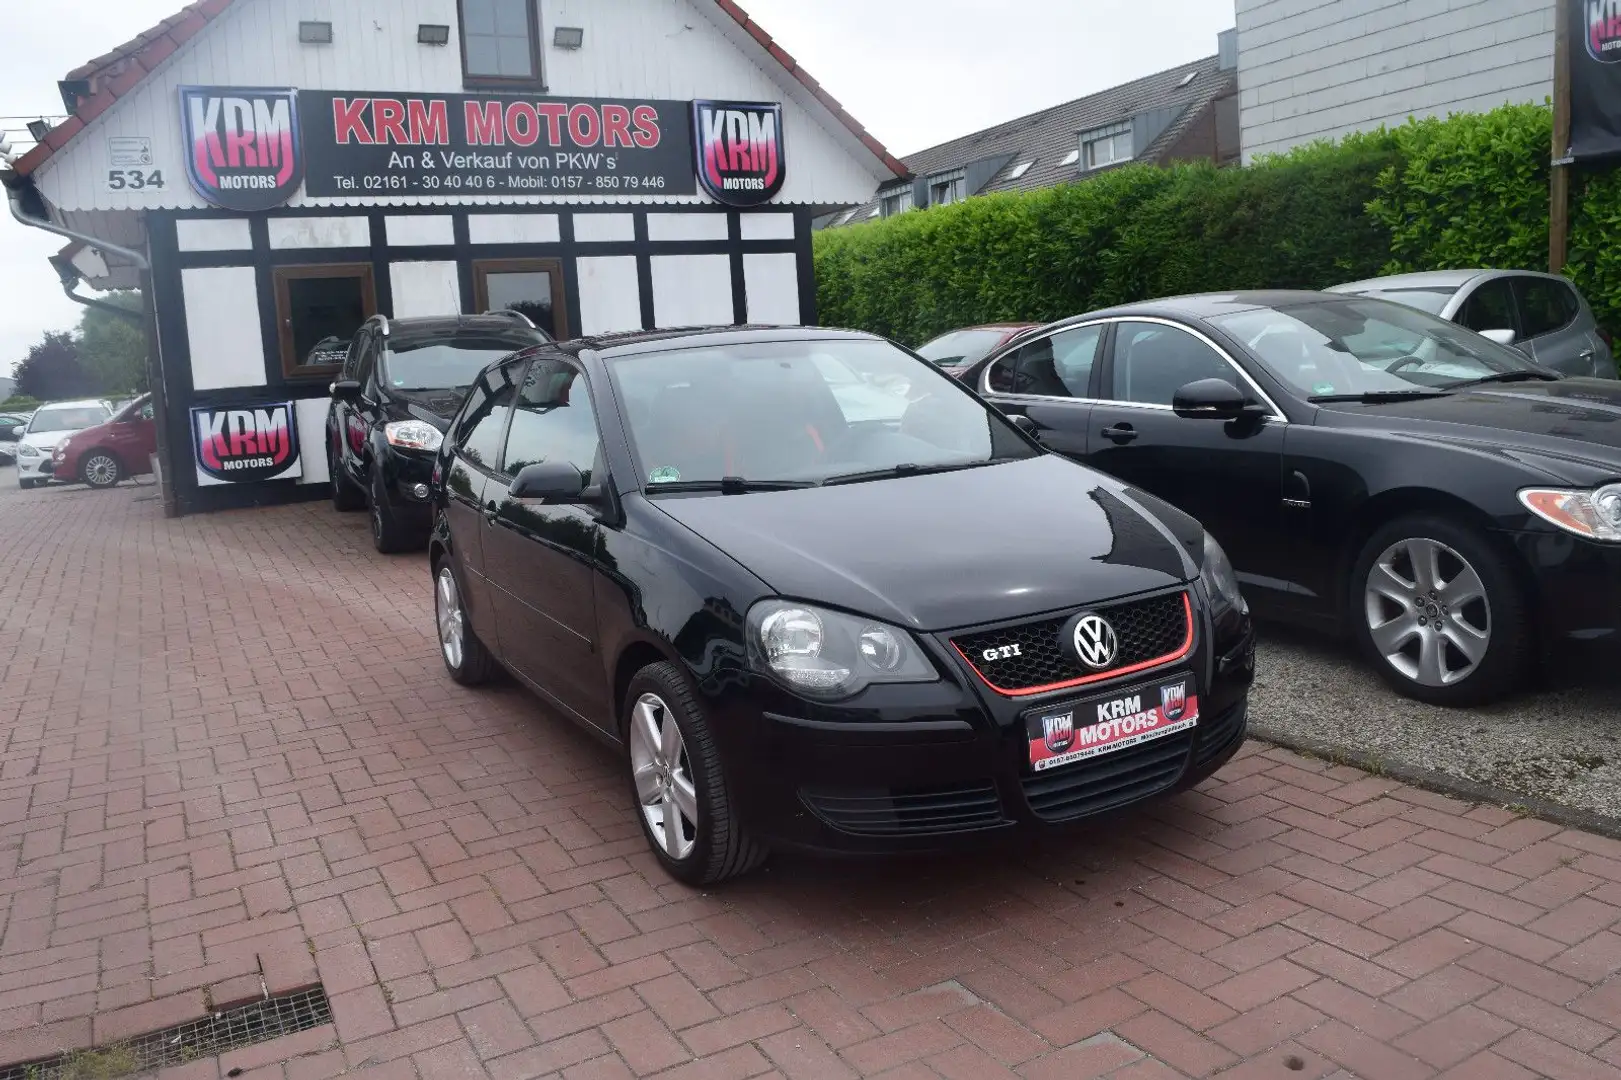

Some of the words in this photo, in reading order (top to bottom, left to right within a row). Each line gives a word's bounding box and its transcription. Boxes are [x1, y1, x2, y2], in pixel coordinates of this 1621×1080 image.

[332, 97, 449, 146] KRM
[464, 100, 660, 149] MOTORS
[190, 97, 294, 188] KRM
[702, 109, 777, 189] KRM
[388, 152, 414, 170] An
[420, 153, 435, 170] &
[442, 151, 513, 169] Verkauf
[517, 157, 550, 169] von
[108, 170, 165, 190] 534
[219, 175, 277, 190] MOTORS
[334, 176, 359, 190] Tel.
[363, 176, 408, 190] 02161
[422, 175, 440, 189] 30
[443, 175, 461, 189] 40
[465, 175, 482, 189] 40
[486, 175, 495, 189] 6
[508, 175, 548, 189] Mobil:
[551, 175, 583, 189] 0157
[596, 175, 619, 189] 850
[623, 175, 639, 189] 79
[642, 175, 665, 189] 446
[723, 177, 765, 190] MOTORS
[198, 407, 290, 469] KRM
[223, 457, 274, 471] MOTORS
[982, 643, 1022, 661] GTI
[1097, 695, 1141, 722] KRM
[1080, 709, 1158, 746] MOTORS
